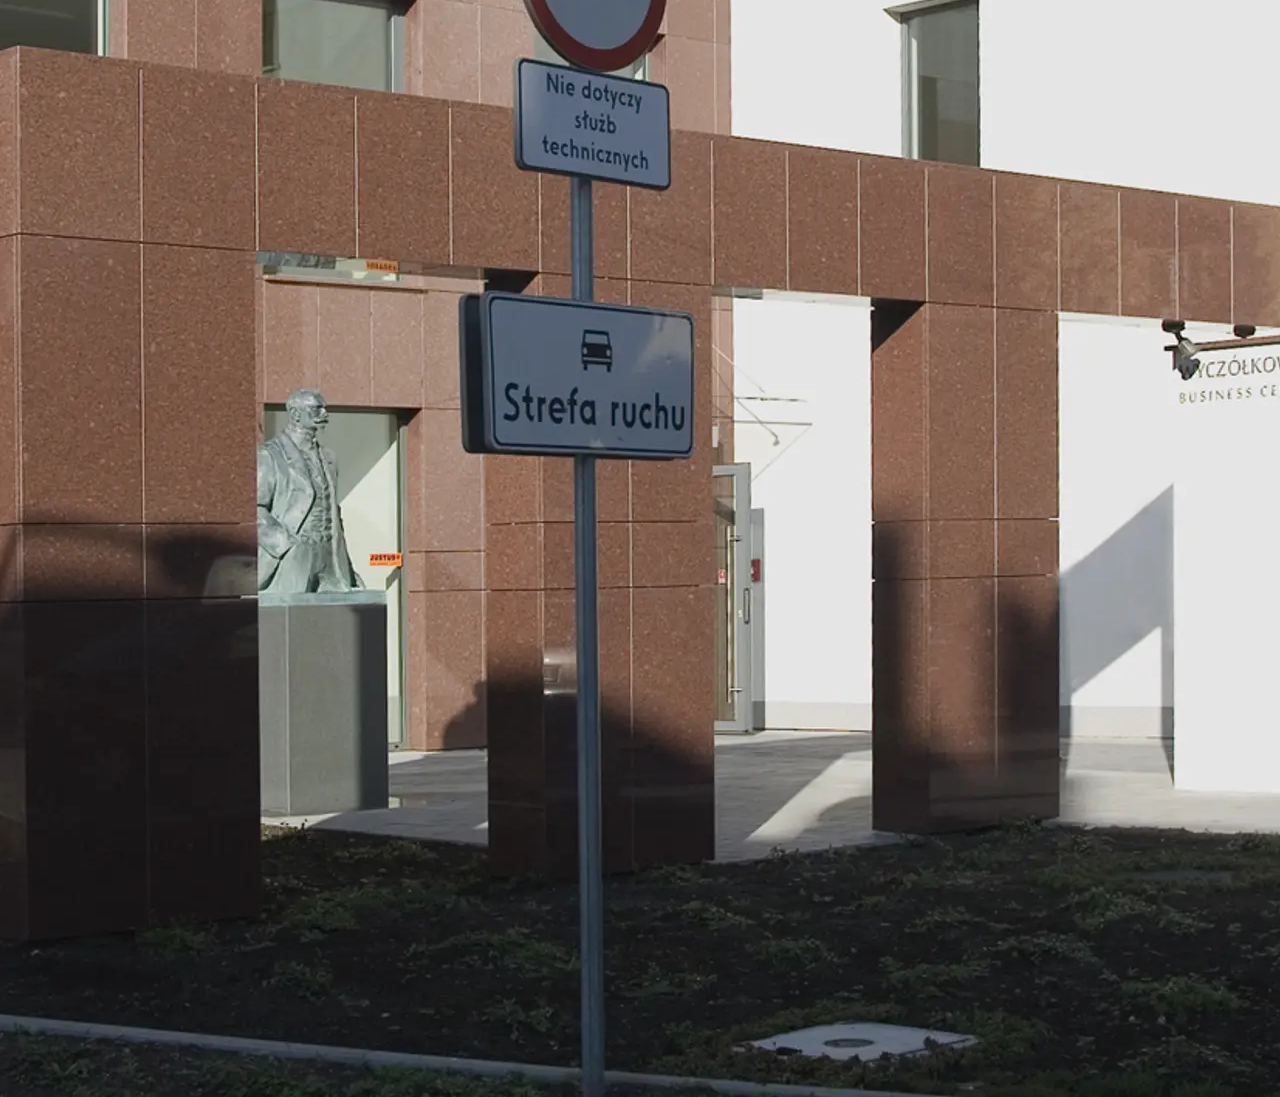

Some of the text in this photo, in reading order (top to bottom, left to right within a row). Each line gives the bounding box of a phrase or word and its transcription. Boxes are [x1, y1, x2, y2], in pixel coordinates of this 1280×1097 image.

[546, 71, 642, 114] Nie dotyczy
[575, 110, 617, 134] służb
[542, 134, 649, 172] technicznych
[503, 382, 685, 431] Strefa ruchu
[1179, 386, 1252, 404] BUSINESS
